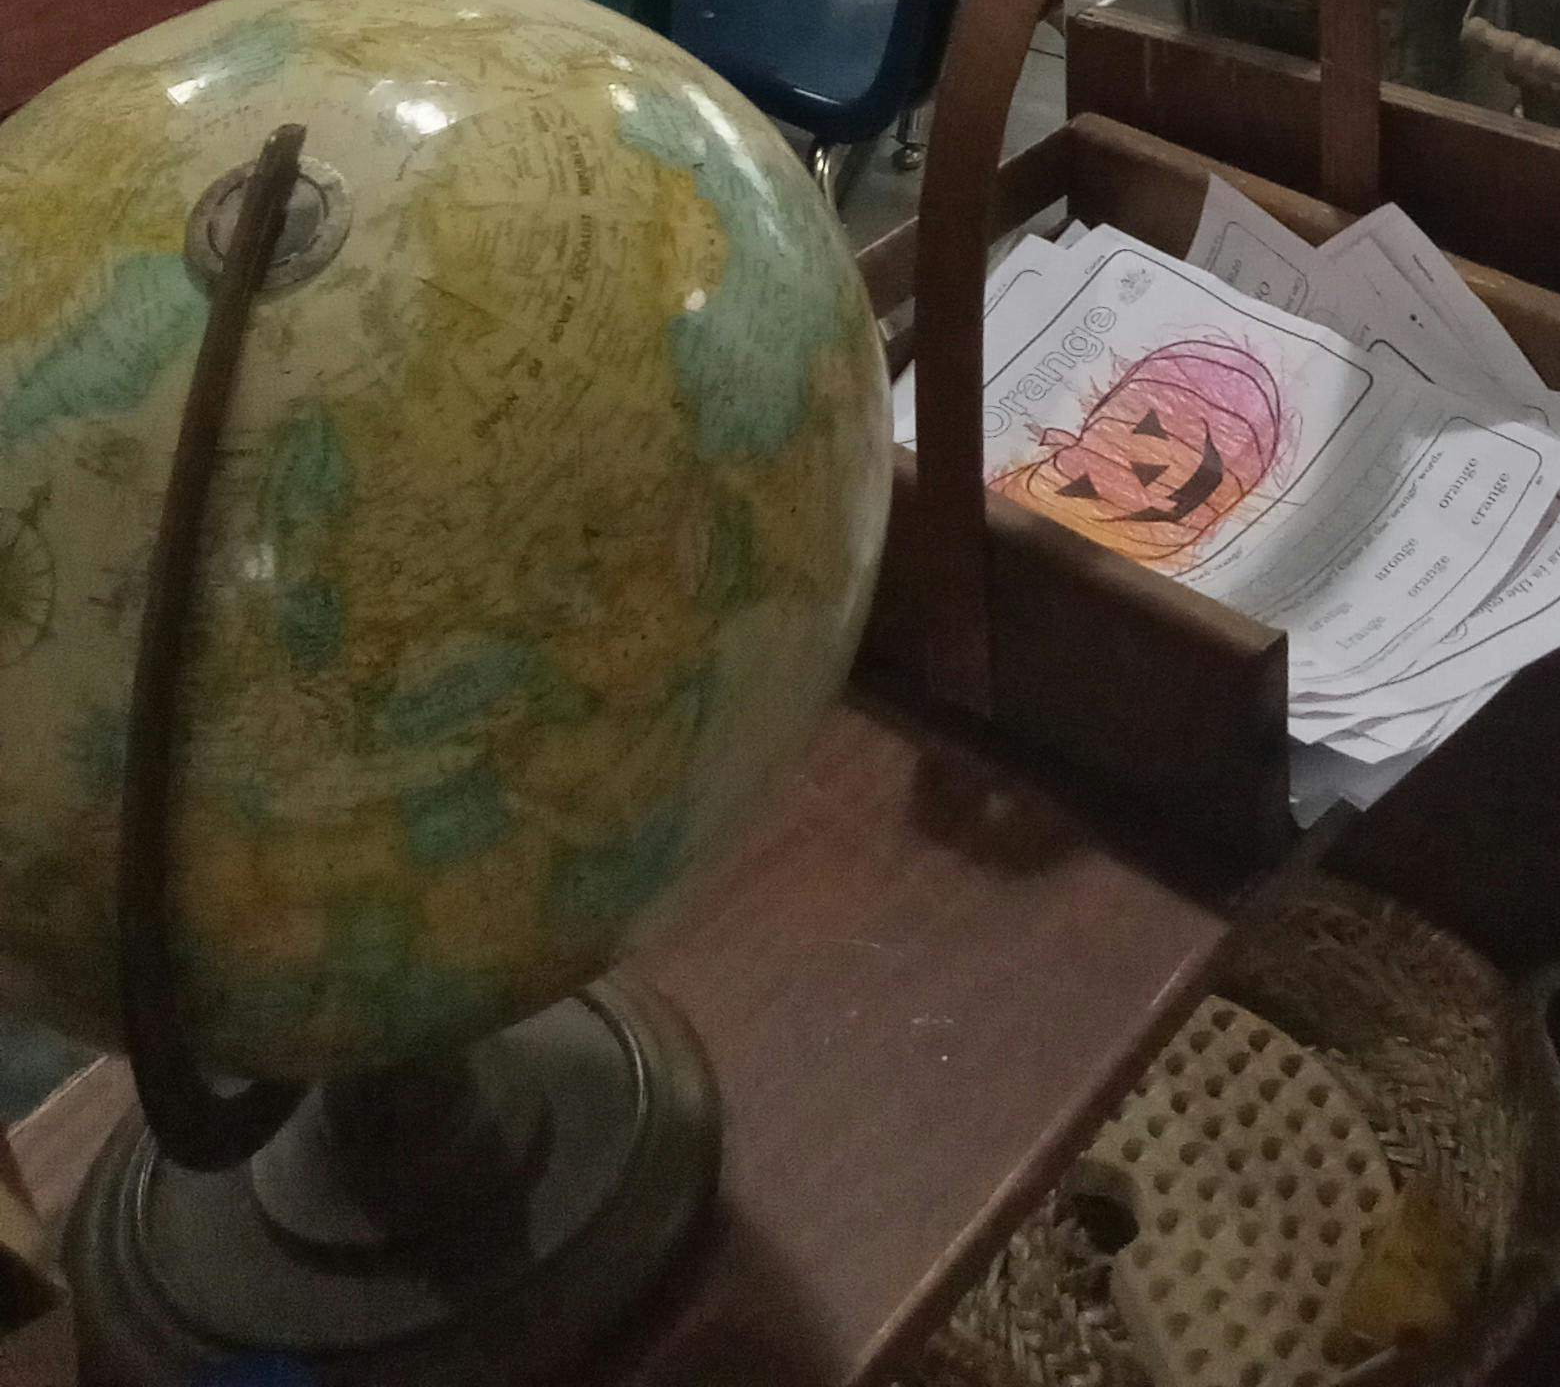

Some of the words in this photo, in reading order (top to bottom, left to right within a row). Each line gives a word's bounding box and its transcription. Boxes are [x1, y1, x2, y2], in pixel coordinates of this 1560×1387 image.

[983, 306, 1117, 439] Orange
[1439, 457, 1479, 510] orange
[1506, 578, 1534, 599] the
[1532, 563, 1551, 580] is
